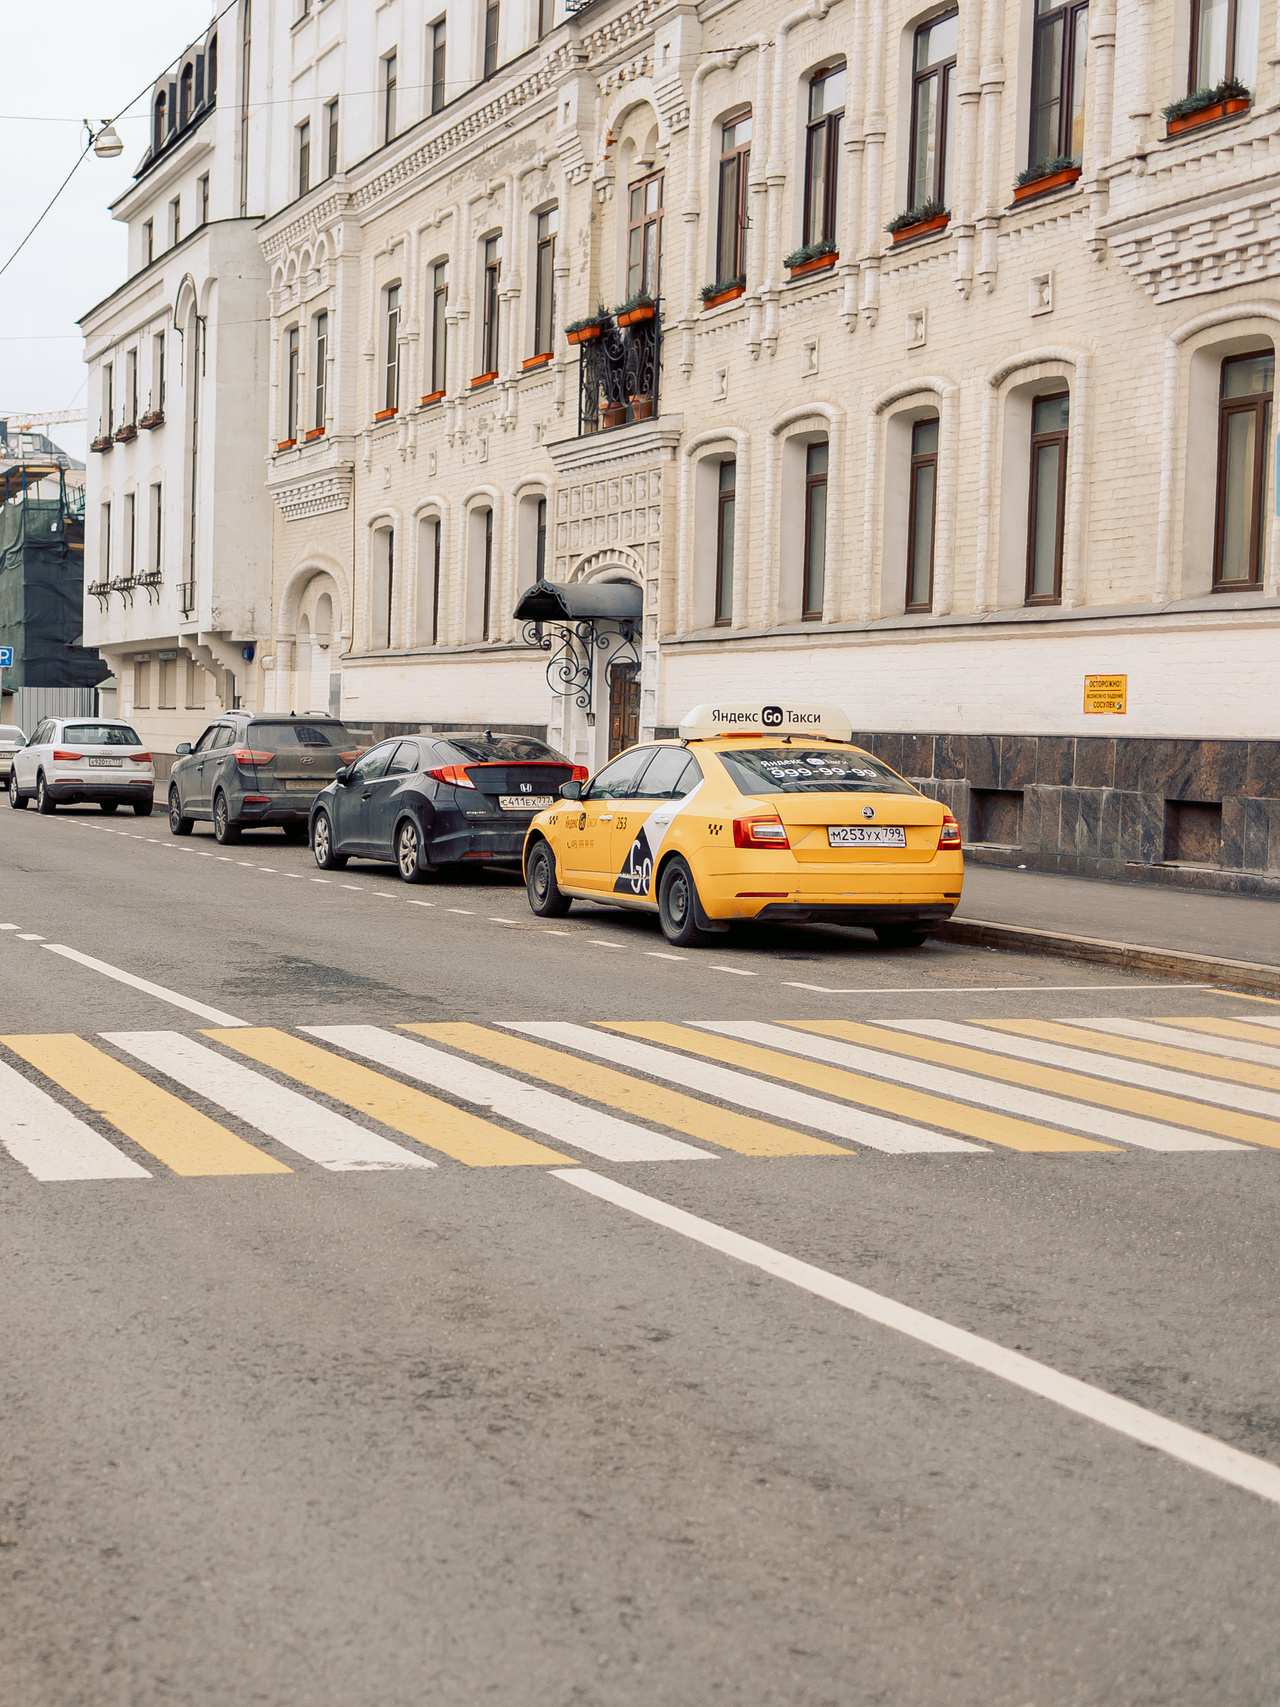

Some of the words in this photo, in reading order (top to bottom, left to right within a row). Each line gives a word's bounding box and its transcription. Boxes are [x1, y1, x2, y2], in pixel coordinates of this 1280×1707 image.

[0, 649, 9, 664] P
[1089, 680, 1122, 688] ОСТОРОЖНО!
[1093, 701, 1115, 709] СОСУЛЕК
[712, 709, 759, 724] Яндекс
[764, 709, 782, 723] Go
[786, 710, 821, 723] Такси
[760, 759, 804, 768] Яндекс
[773, 768, 878, 778] 999-99-99
[616, 817, 627, 830] 253
[882, 828, 901, 838] 799
[630, 839, 652, 894] Go
